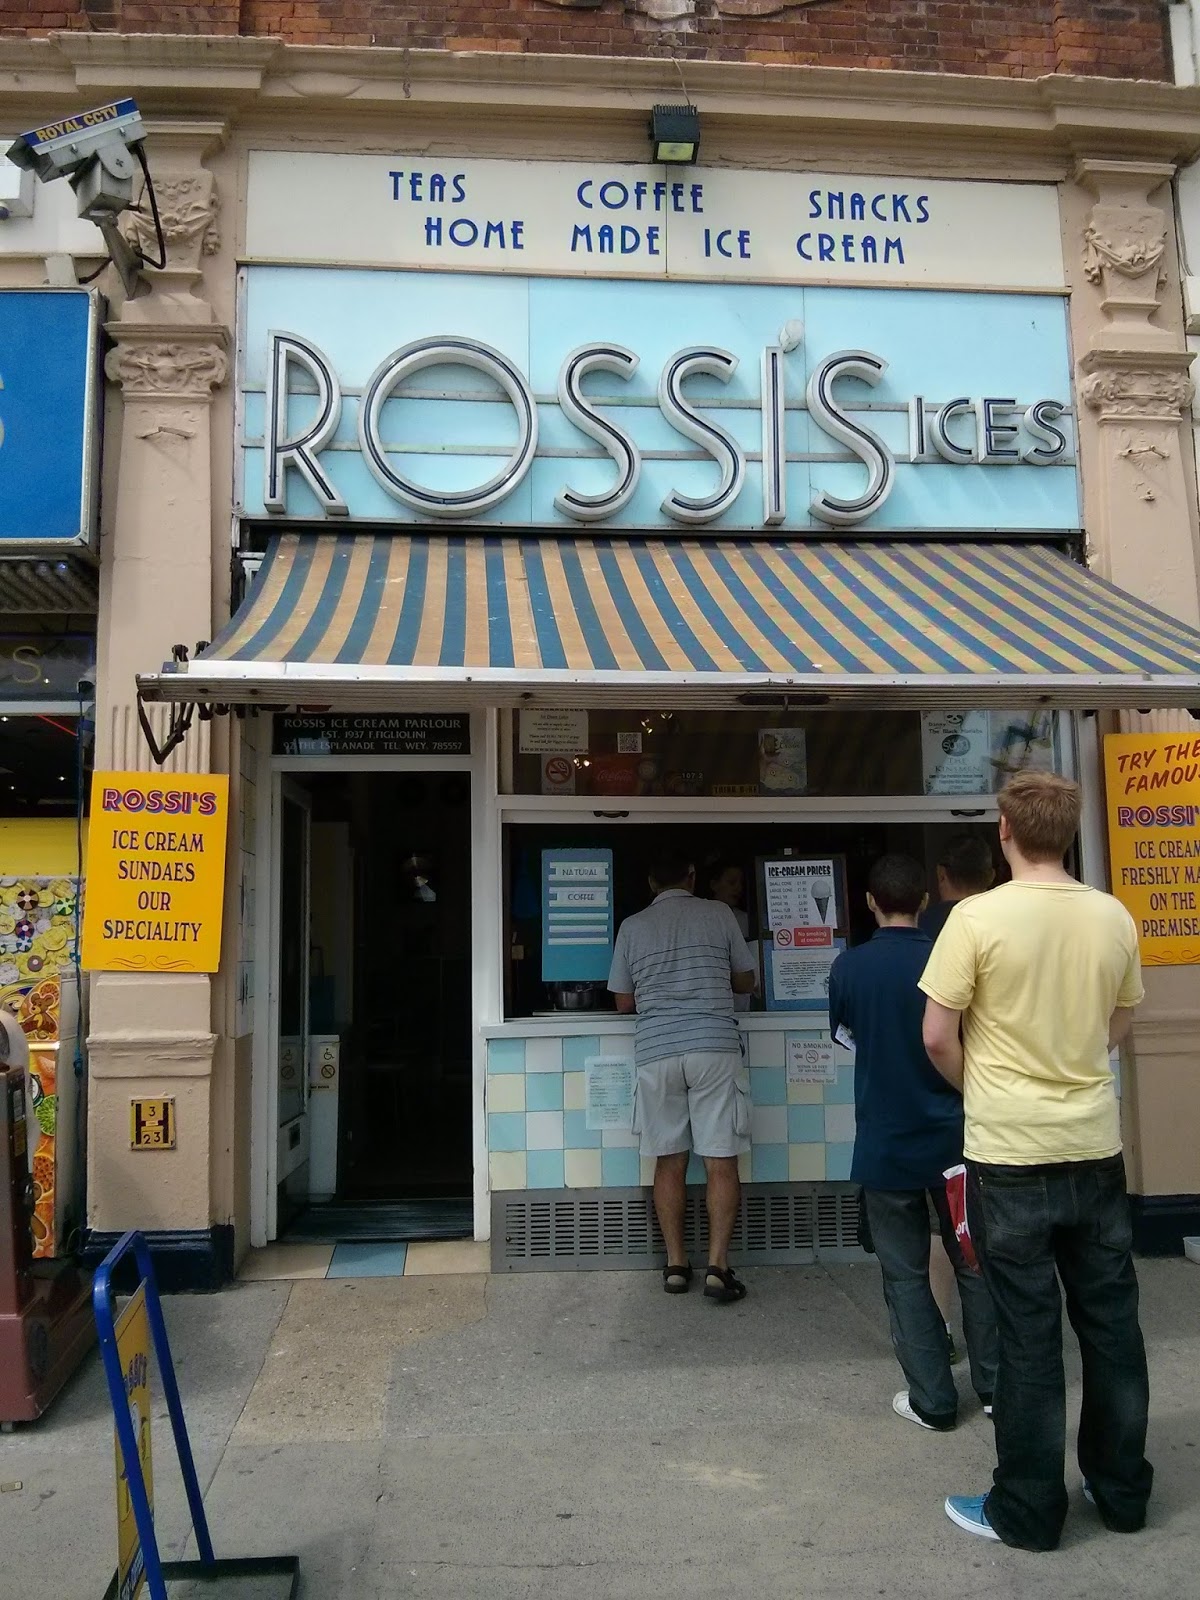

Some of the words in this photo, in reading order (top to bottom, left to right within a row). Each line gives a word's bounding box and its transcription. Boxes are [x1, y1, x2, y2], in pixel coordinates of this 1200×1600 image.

[36, 119, 83, 142] ROYAL
[83, 105, 118, 126] CCTV
[389, 171, 467, 203] TEAS
[576, 180, 704, 213] COFFEE
[808, 190, 930, 223] SNACKS
[424, 216, 524, 249] HOME
[570, 224, 660, 255] MADE
[703, 228, 751, 259] ICE
[796, 233, 905, 264] CREAM
[263, 319, 896, 527] ROSSI'S
[908, 394, 1068, 467] ICES
[284, 718, 326, 729] ROSSIS
[331, 718, 349, 729] ICE
[353, 718, 400, 729] CREAM
[404, 718, 462, 729] PARLOUR
[344, 730, 364, 739] 1937
[299, 741, 316, 750] THE
[319, 741, 375, 750] ESPLANADE
[1117, 749, 1157, 773] TRY
[1164, 739, 1200, 764] THE
[1124, 763, 1200, 795] FAMOU
[102, 788, 217, 815] ROSSI'S
[112, 830, 140, 850] ICE
[145, 831, 204, 853] CREAM
[1134, 841, 1156, 859] ICE
[1158, 840, 1200, 859] CREAM
[118, 860, 196, 882] SUNDAES
[562, 868, 598, 876] NATURAL
[768, 865, 805, 877] ICE-CREAM
[807, 865, 831, 876] PRICES
[1121, 866, 1180, 885] FRESHLY
[138, 890, 171, 911] OUR
[567, 893, 595, 901] COFFEE
[1149, 892, 1168, 911] ON
[1171, 891, 1197, 910] THE
[103, 919, 202, 942] SPECIALITY
[1141, 918, 1200, 938] PREMISE
[148, 1106, 156, 1117] 3
[143, 1131, 161, 1144] 23
